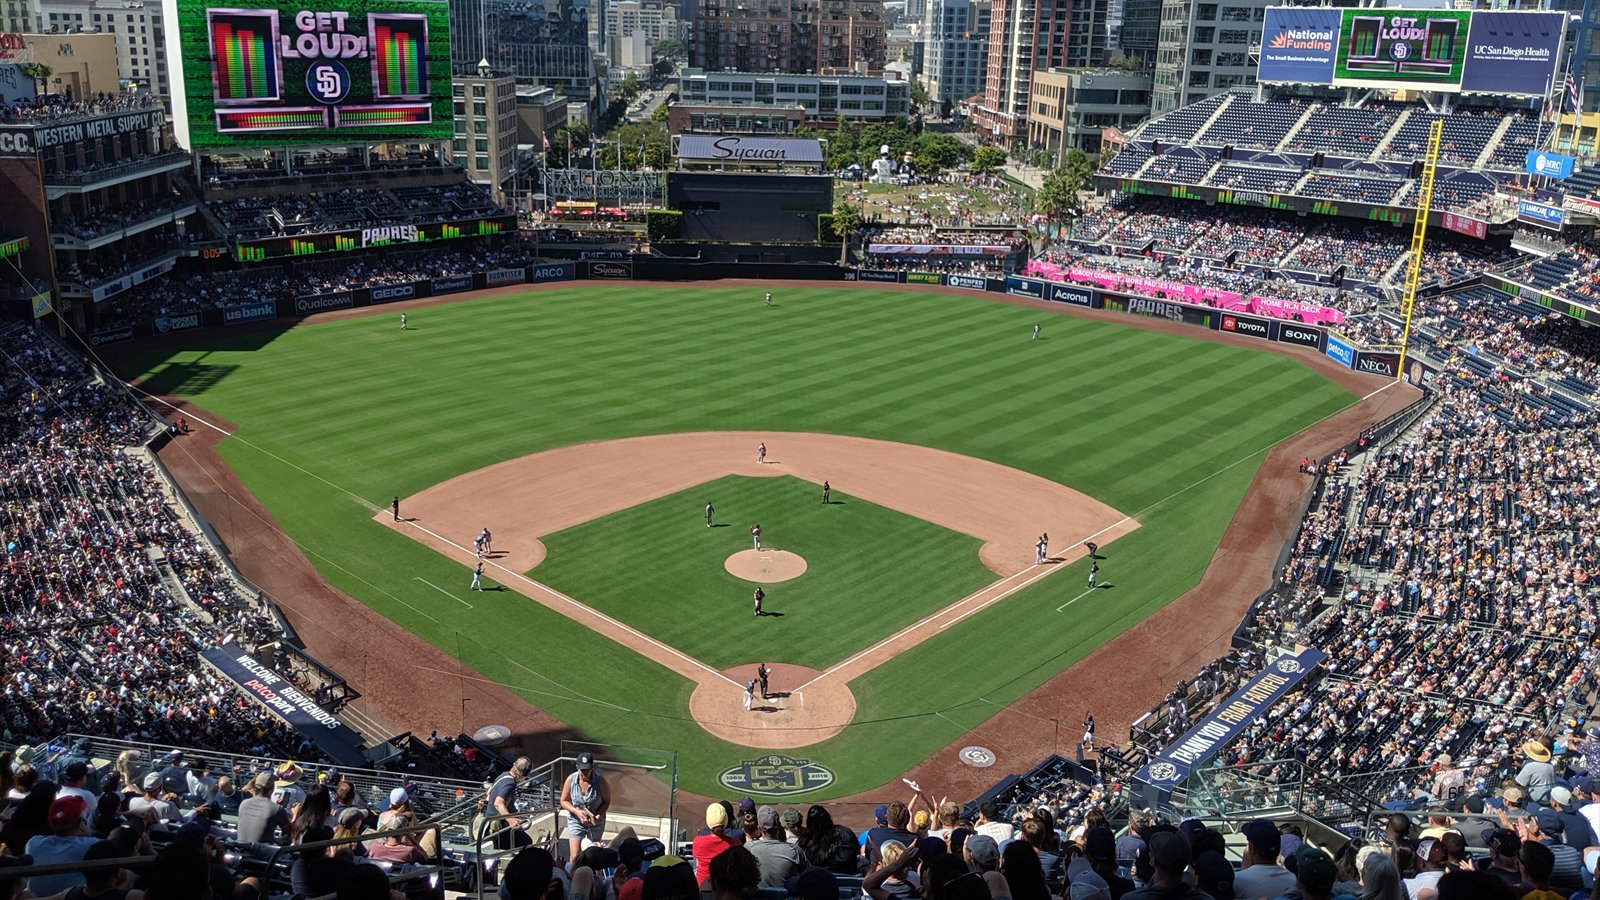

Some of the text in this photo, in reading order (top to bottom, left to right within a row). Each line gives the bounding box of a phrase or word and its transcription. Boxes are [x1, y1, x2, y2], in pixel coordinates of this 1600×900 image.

[296, 10, 349, 32] GET
[1391, 16, 1417, 28] GET
[1288, 30, 1333, 40] National
[1382, 28, 1424, 40] LOUD!
[281, 33, 368, 58] LOUD!
[1287, 40, 1331, 51] Funding
[1474, 45, 1550, 56] UC San Diego Health
[35, 111, 166, 148] WESTERN METAL SUPPLY CO.
[0, 132, 35, 153] CO.
[712, 137, 788, 164] Sycuan
[538, 168, 665, 187] NATIONAL
[552, 186, 657, 199] UNIVERSITY
[1235, 192, 1268, 204] PADRES
[362, 224, 419, 248] PADRES
[488, 270, 522, 281] BUDWEISER
[535, 268, 564, 278] ARCO
[593, 264, 626, 275] Sycuan
[434, 281, 466, 290] Southwest
[959, 278, 984, 286] PENFED
[1072, 269, 1093, 278] NOBODY
[1169, 284, 1185, 292] FANS
[372, 286, 413, 300] GEICO
[1055, 290, 1088, 303] Acronis
[297, 296, 350, 311] Qualcomm
[1128, 298, 1183, 322] PADRES
[1261, 299, 1282, 307] HOME
[1300, 305, 1321, 314] DECK
[1237, 322, 1266, 333] TOYOTA
[101, 330, 132, 343] everbowl
[1285, 330, 1318, 342] SONY
[1328, 343, 1344, 357] petco
[1360, 360, 1391, 374] NECA
[236, 654, 341, 729] WELCOME BIENVENIDOS
[1168, 673, 1289, 764] THANK YOU FRIAR FAITHFUL
